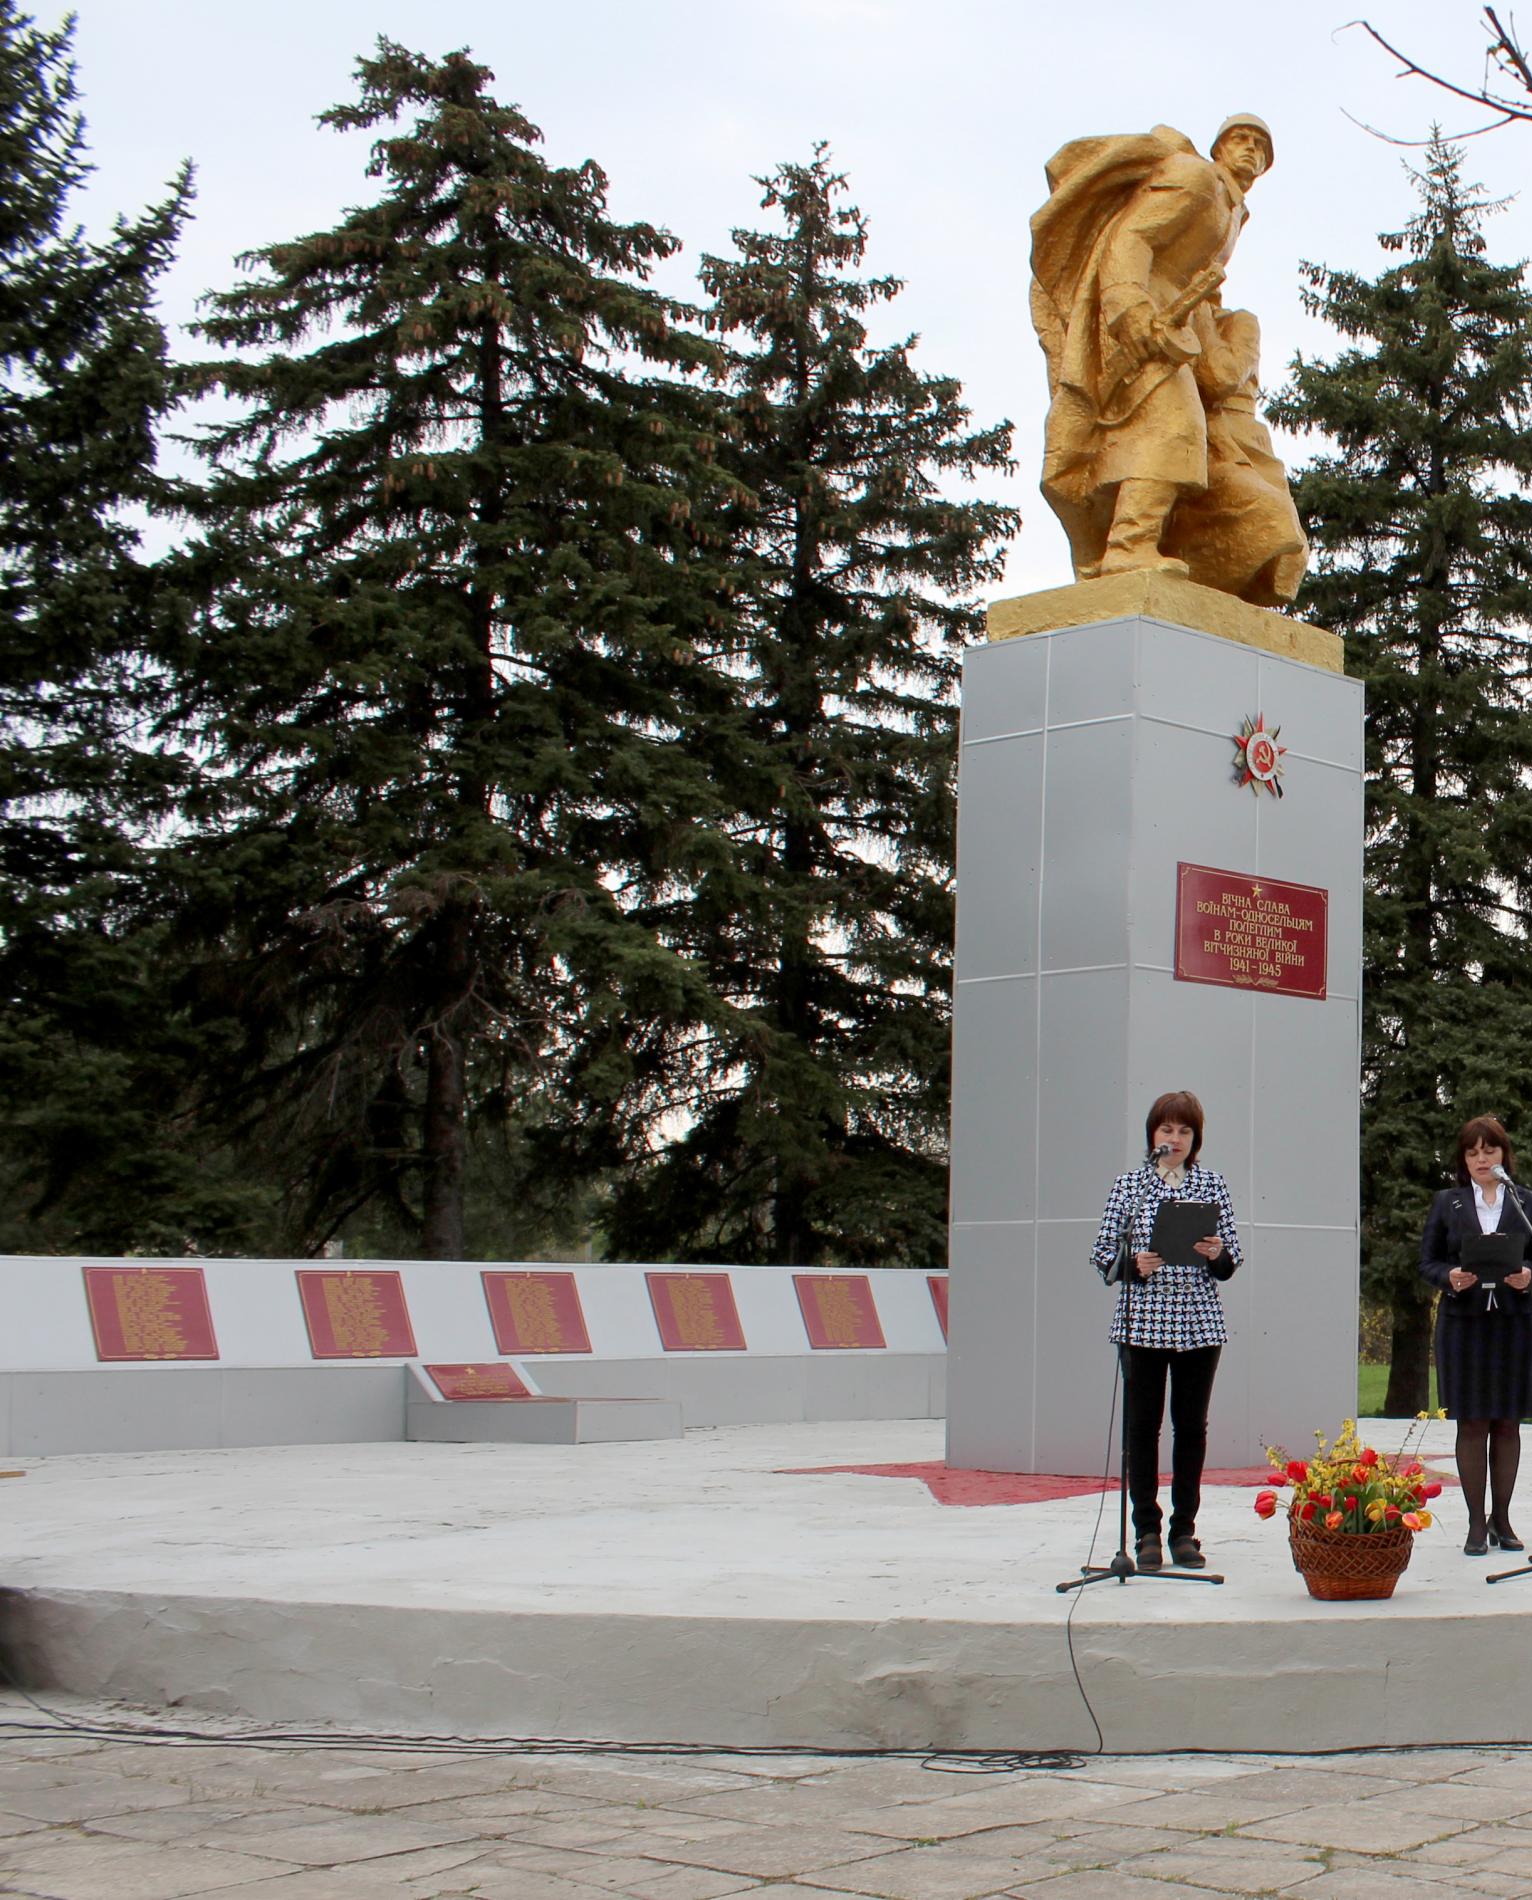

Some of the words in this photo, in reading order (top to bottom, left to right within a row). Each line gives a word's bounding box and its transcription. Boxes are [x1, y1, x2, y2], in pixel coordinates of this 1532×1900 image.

[1222, 893, 1251, 909] ВІЧНА
[1257, 900, 1290, 916] СЛАВА
[1229, 920, 1282, 938] ПОЛЕГЛИМ
[1214, 929, 1221, 941] В
[1226, 932, 1252, 946] РОКИ
[1256, 936, 1297, 953] ВЕЛИКОЇ
[1204, 940, 1270, 961] ВІТЧИЗНЯНОЇ
[1275, 952, 1305, 967] ВІЙНИ
